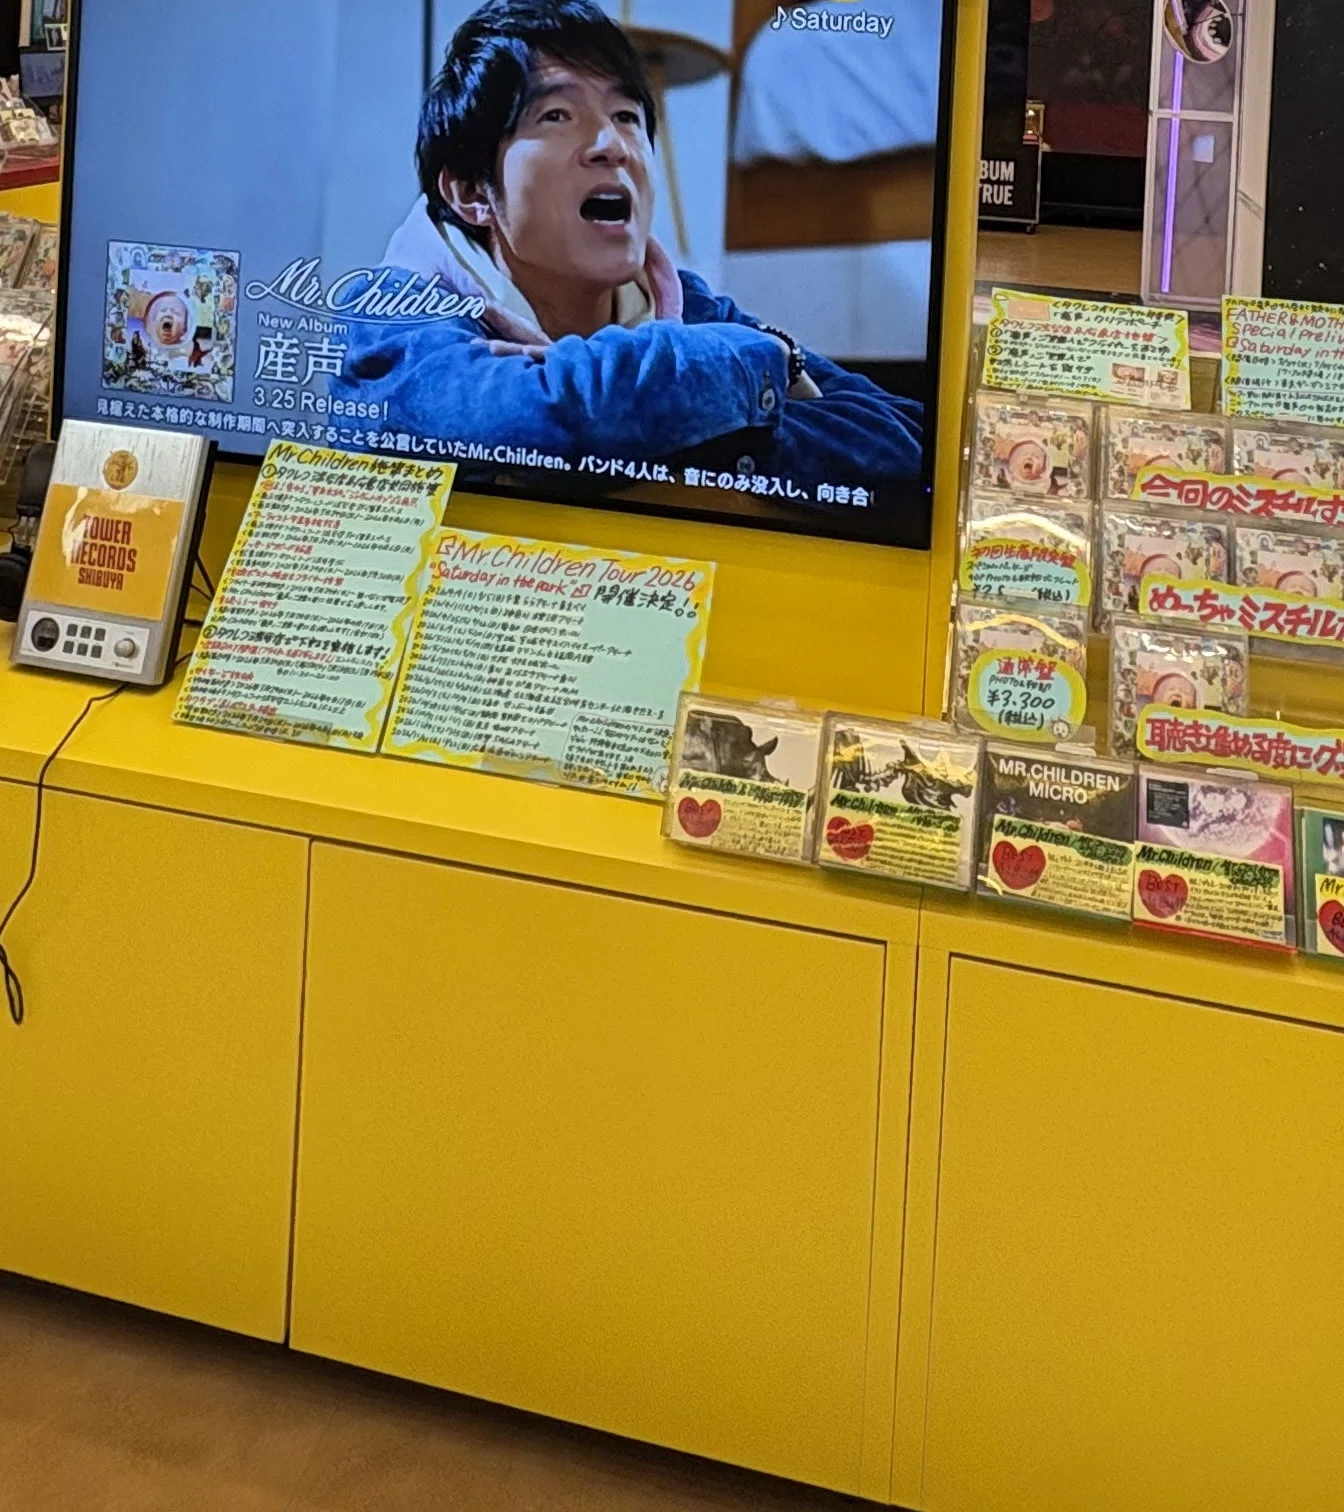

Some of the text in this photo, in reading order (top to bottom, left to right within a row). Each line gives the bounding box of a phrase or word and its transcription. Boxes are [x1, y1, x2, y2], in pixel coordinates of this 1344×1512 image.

[791, 6, 895, 38] Saturday
[978, 183, 1015, 206] RUE
[258, 313, 349, 336] New Album
[255, 332, 349, 386] 産声
[1315, 346, 1330, 359] in
[254, 387, 390, 422] 3.25 Release!
[82, 513, 133, 545] TOWER
[77, 566, 125, 591] SHIBUYA
[496, 572, 511, 587] in
[513, 574, 537, 590] the
[597, 558, 647, 587] Tour
[644, 565, 696, 592] 2026
[997, 758, 1122, 792] MR.CHILDREN
[1028, 780, 1089, 805] MICRO
